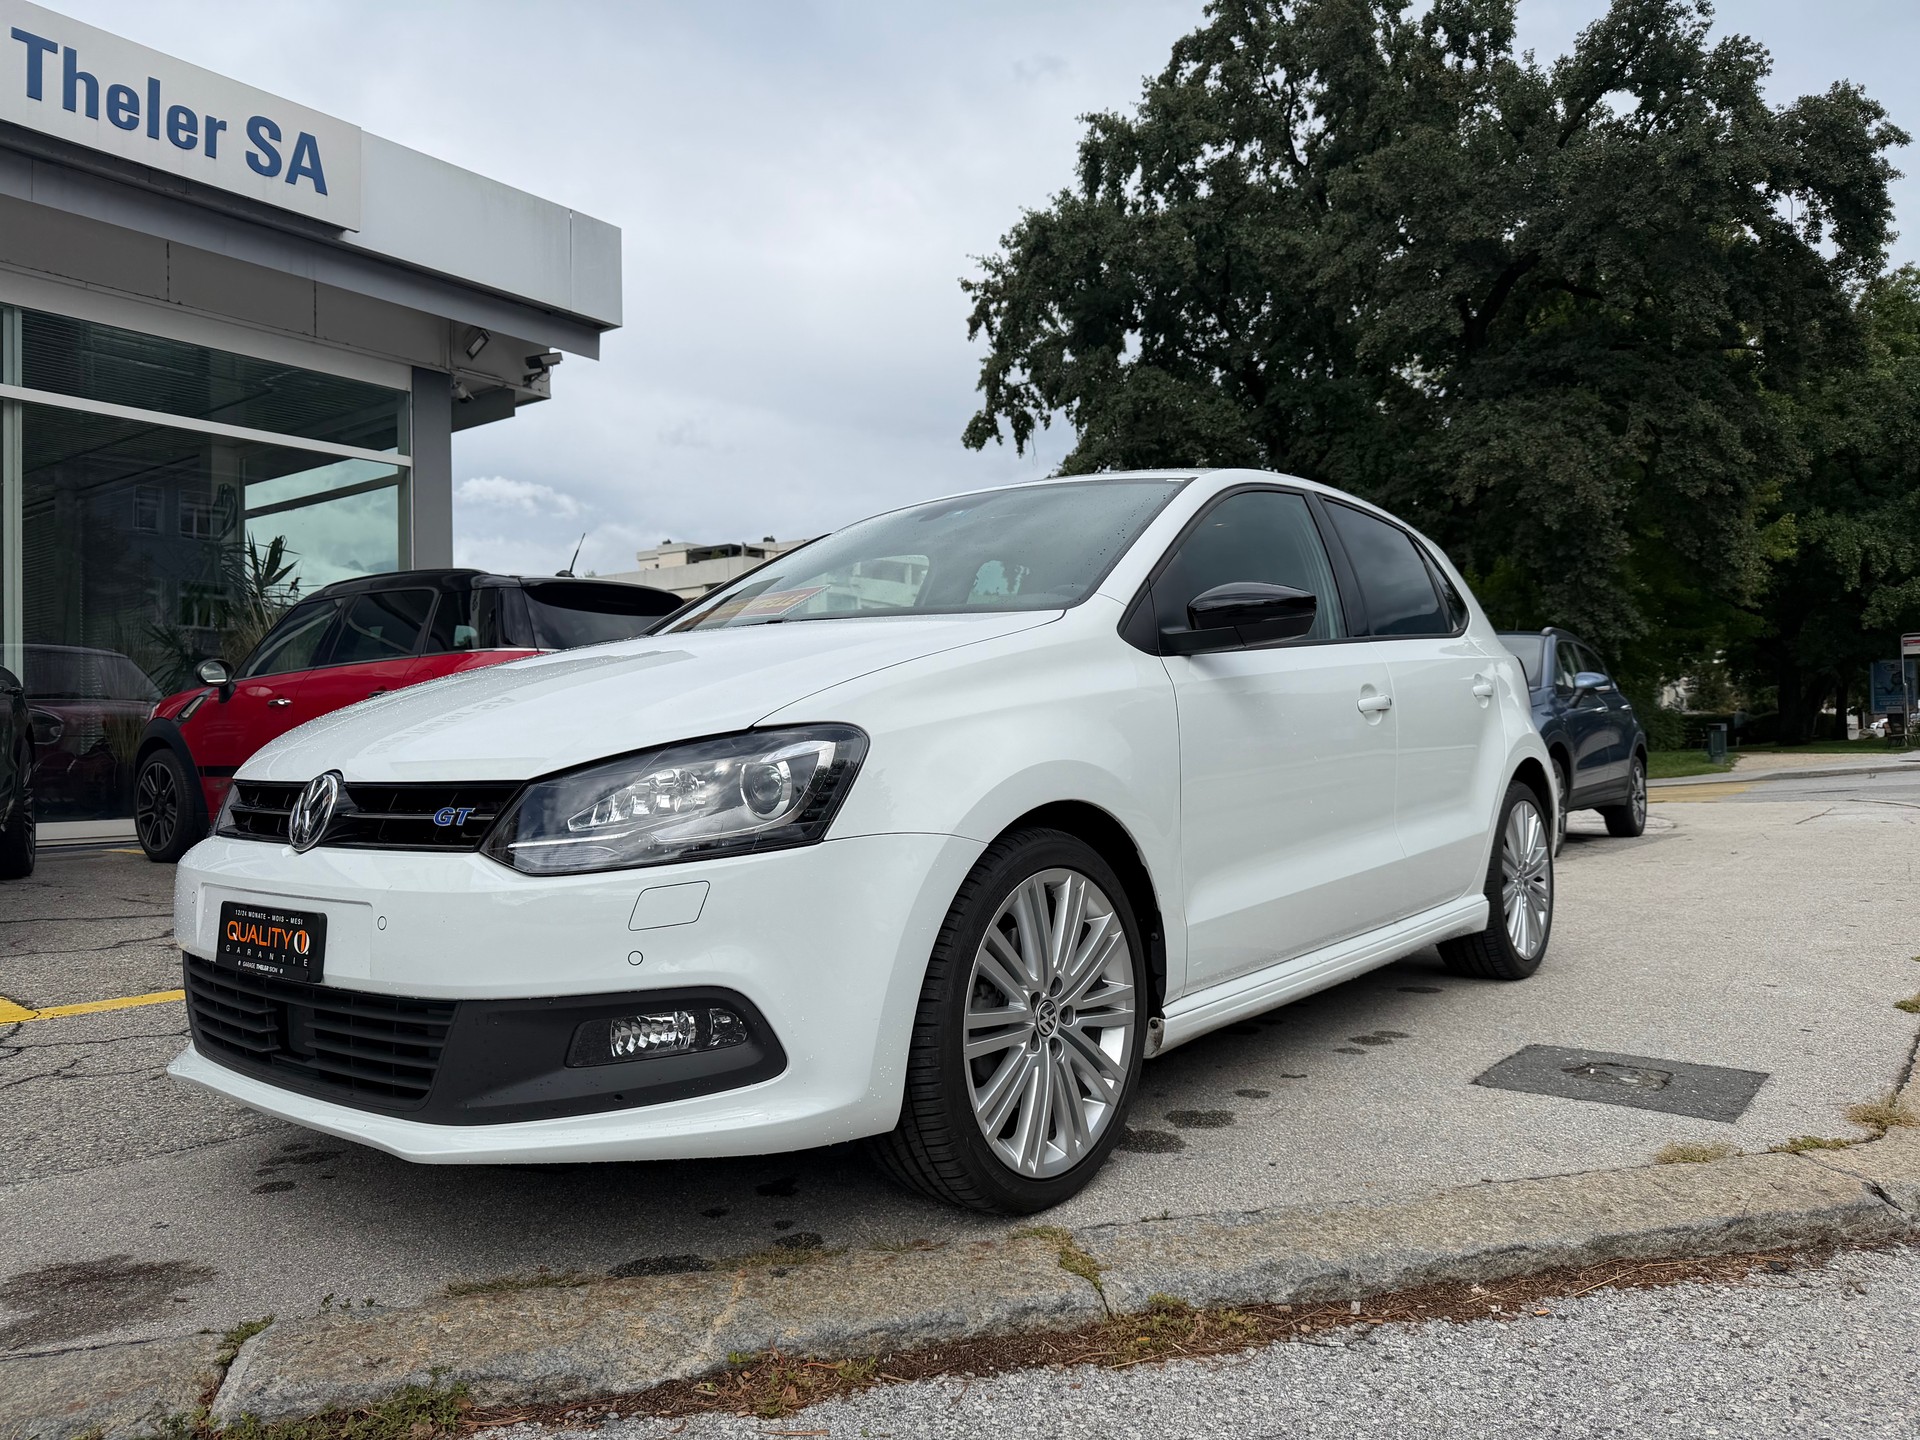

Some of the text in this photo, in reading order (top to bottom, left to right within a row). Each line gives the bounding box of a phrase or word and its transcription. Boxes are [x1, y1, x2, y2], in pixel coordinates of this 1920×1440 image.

[10, 27, 329, 196] Theler SA
[433, 807, 476, 826] GT
[271, 914, 285, 923] MOIS
[225, 944, 308, 967] GARANTIE
